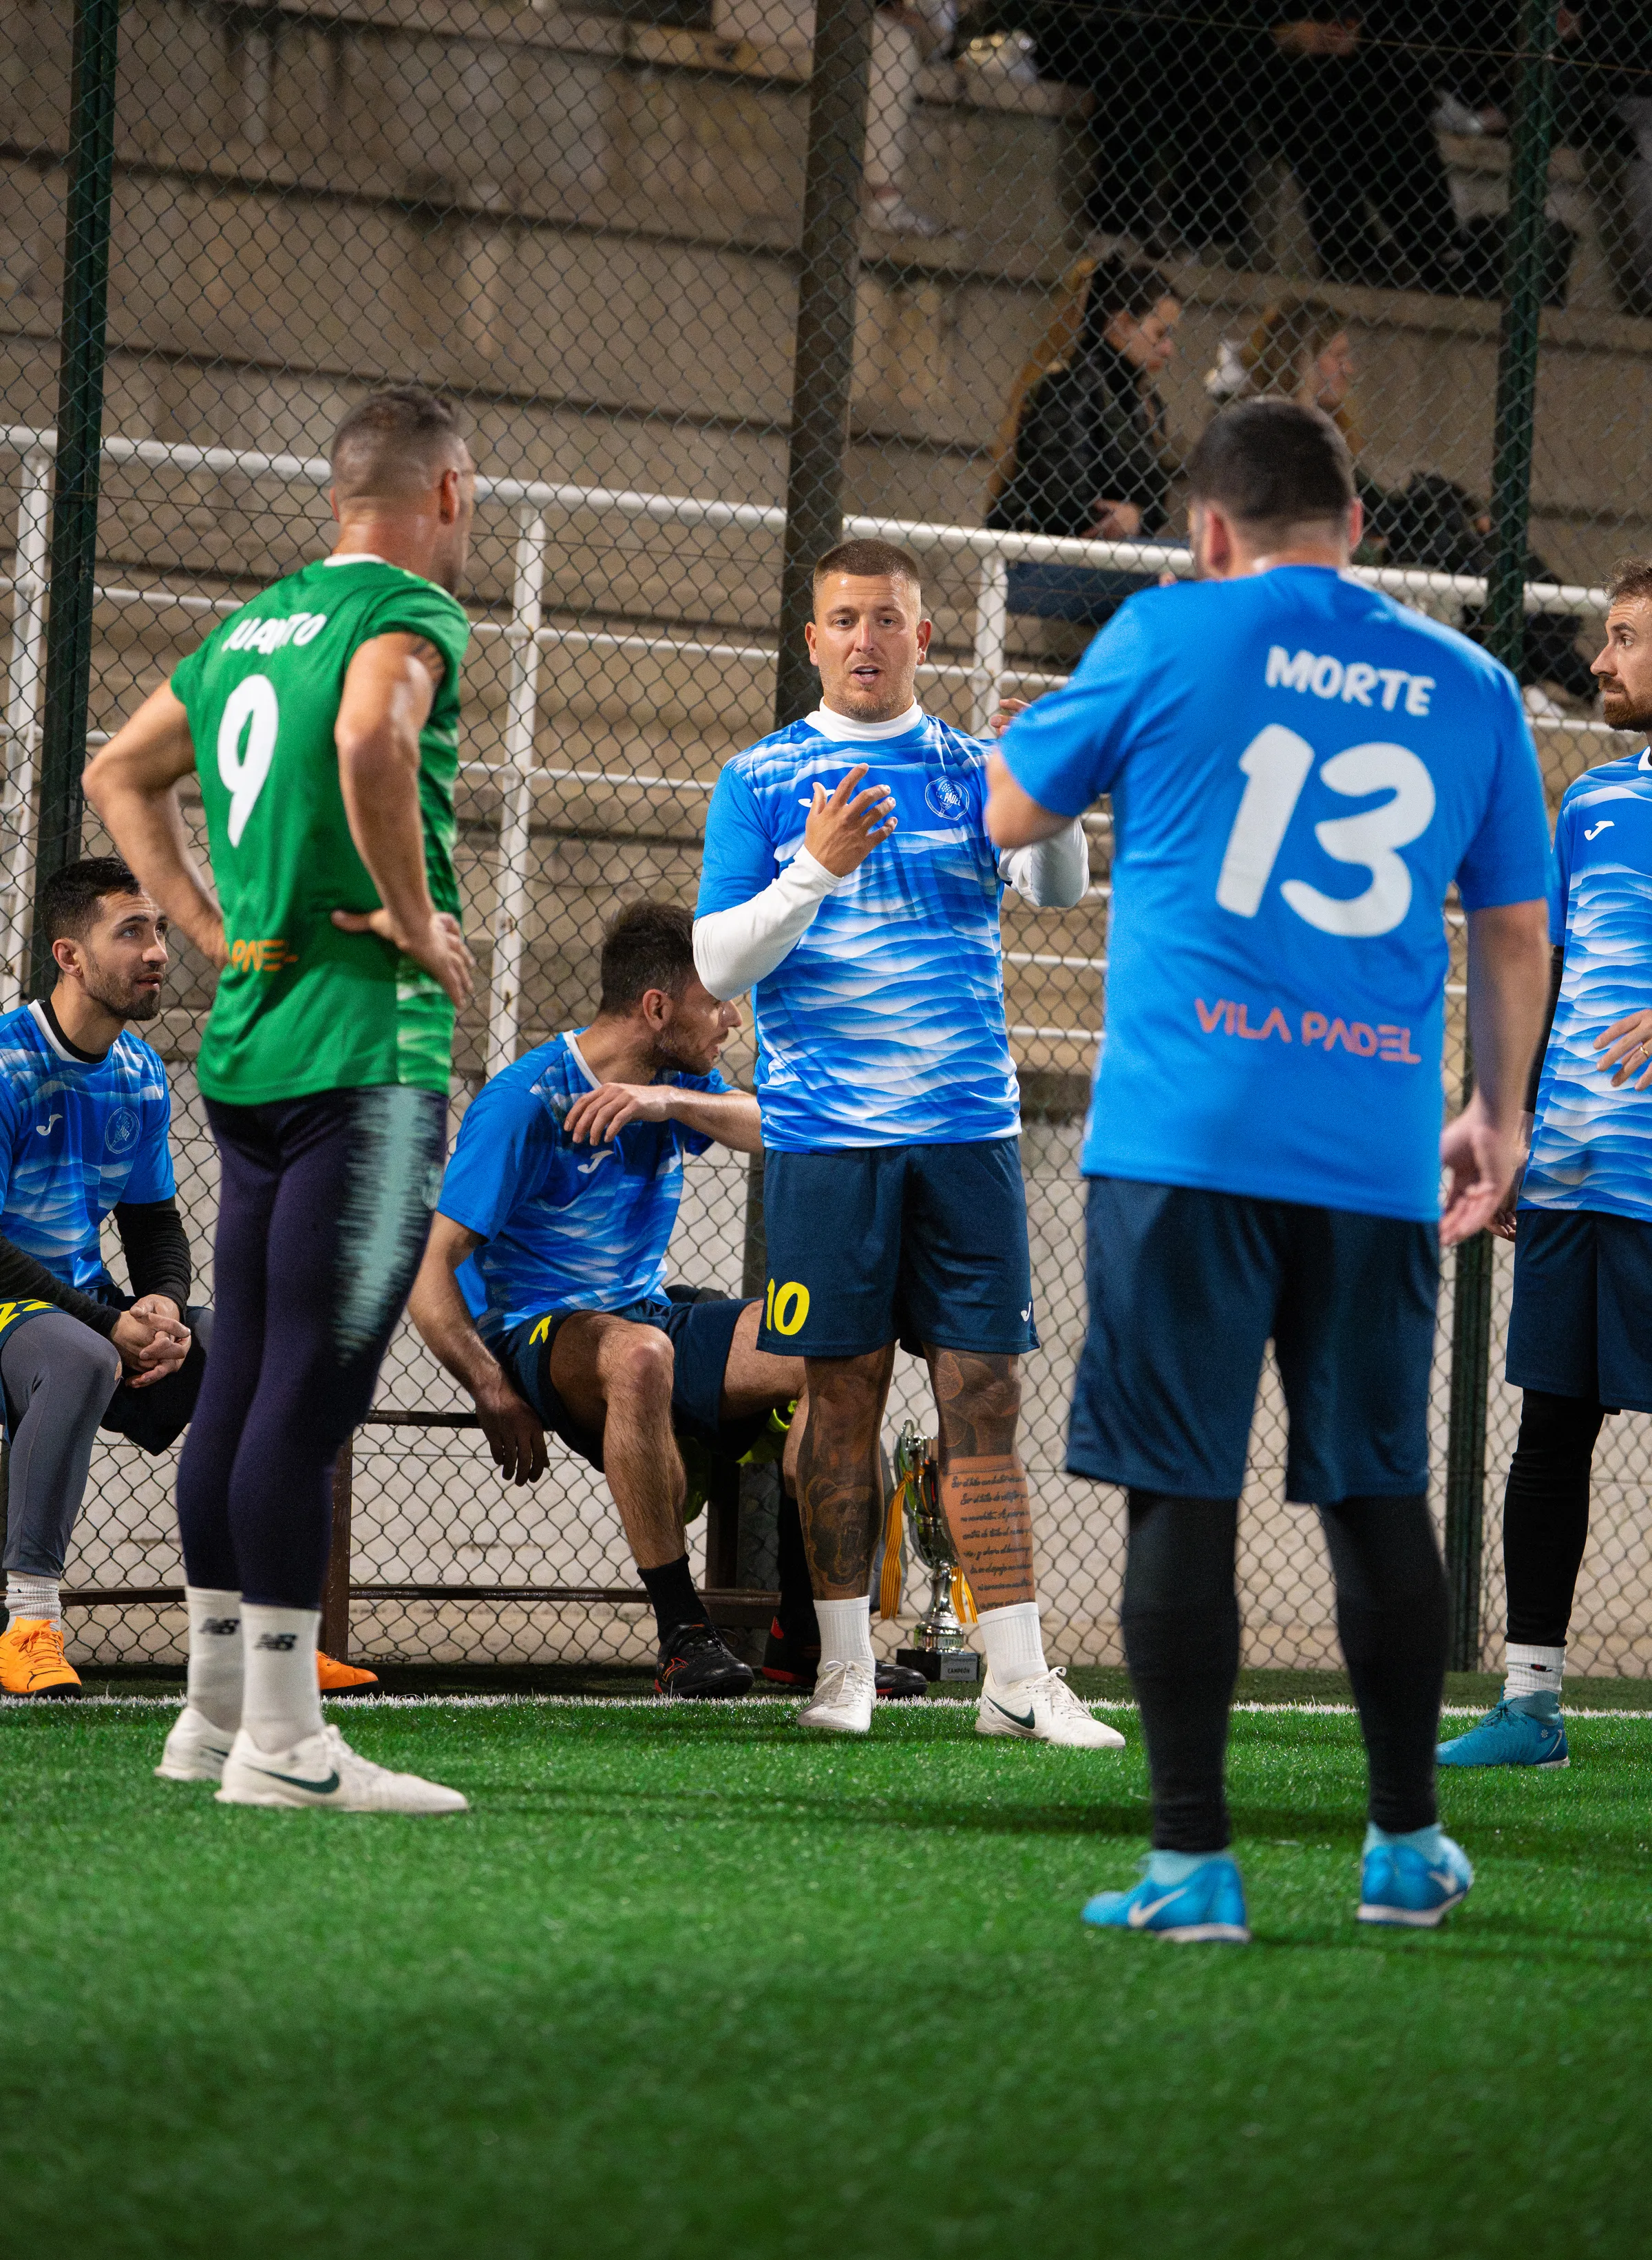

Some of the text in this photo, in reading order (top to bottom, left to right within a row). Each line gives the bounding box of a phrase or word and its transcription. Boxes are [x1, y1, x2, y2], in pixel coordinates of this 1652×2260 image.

[1265, 645, 1436, 717] MORTE
[218, 674, 279, 847] 9
[1216, 723, 1437, 938] 13
[1194, 997, 1421, 1065] VILA PADEL
[766, 1278, 810, 1335] 10
